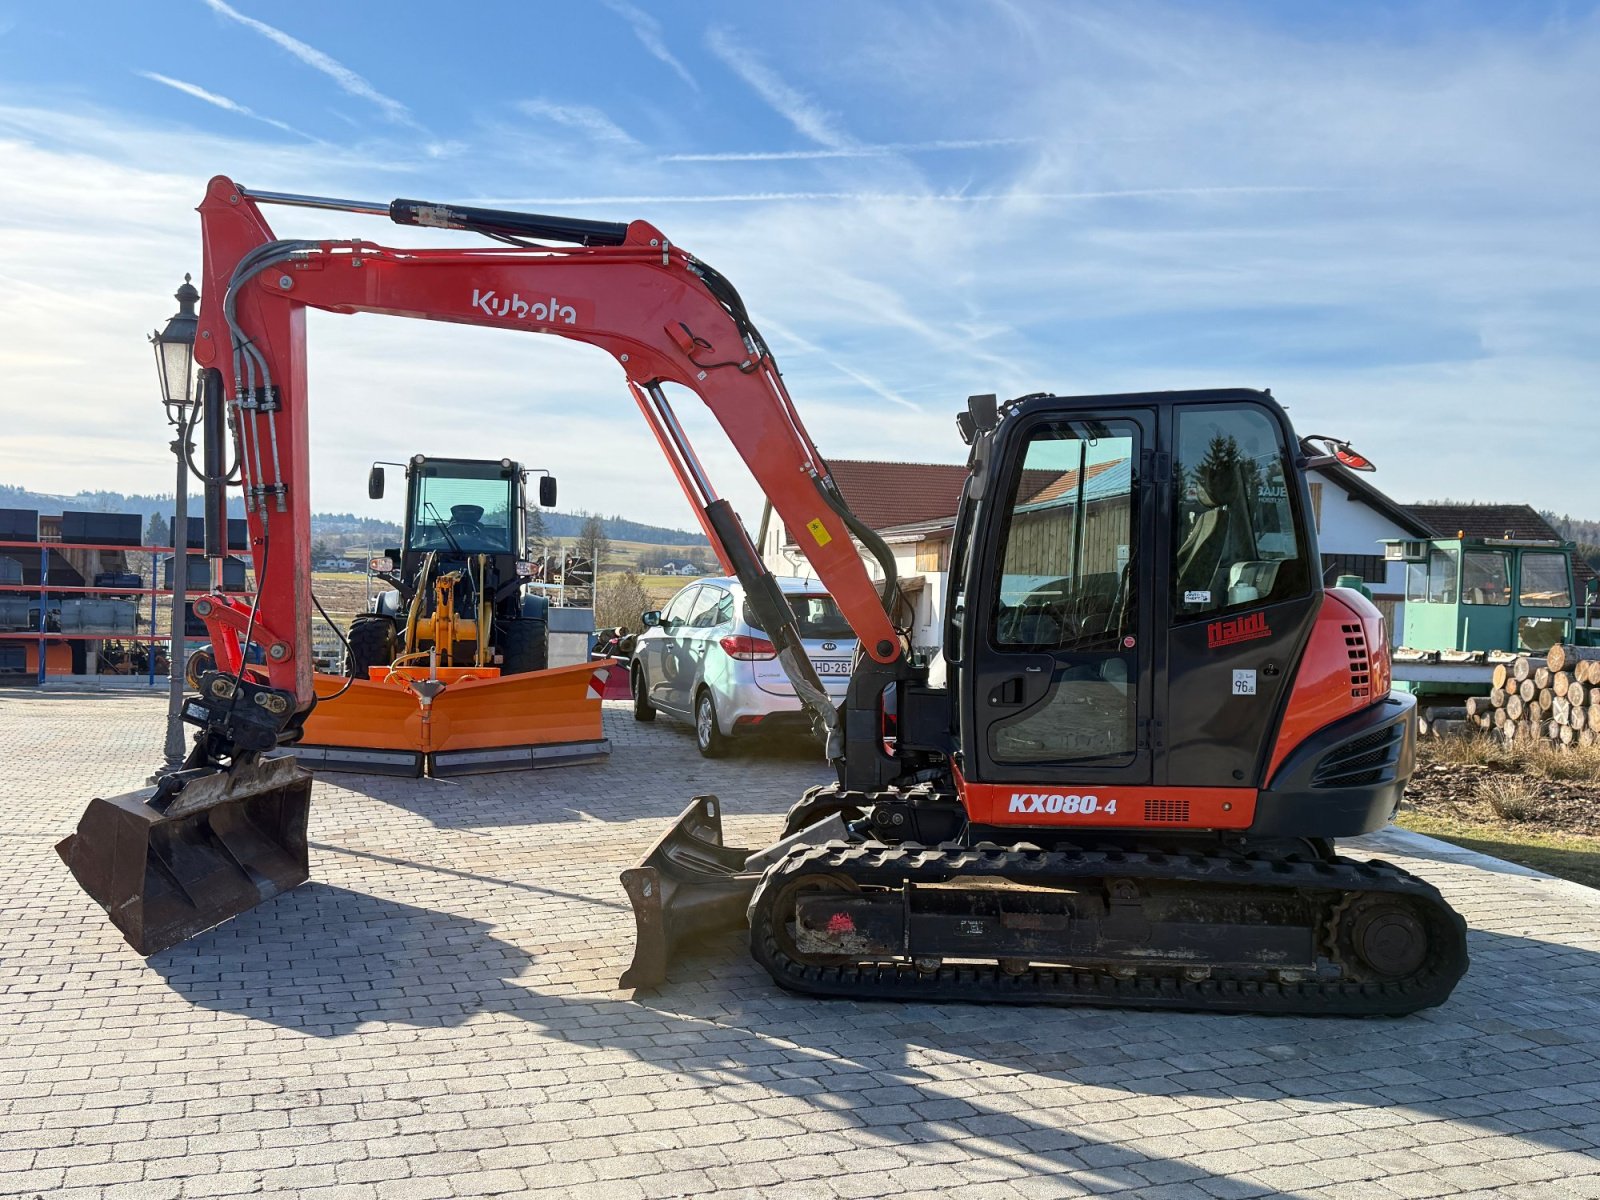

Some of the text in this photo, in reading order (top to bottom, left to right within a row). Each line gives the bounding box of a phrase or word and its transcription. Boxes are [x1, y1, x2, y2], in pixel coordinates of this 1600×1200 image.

[472, 289, 577, 325] Kubota
[1208, 612, 1269, 642] Haidl
[1235, 680, 1248, 693] 96
[1008, 793, 1117, 815] KX080-4
